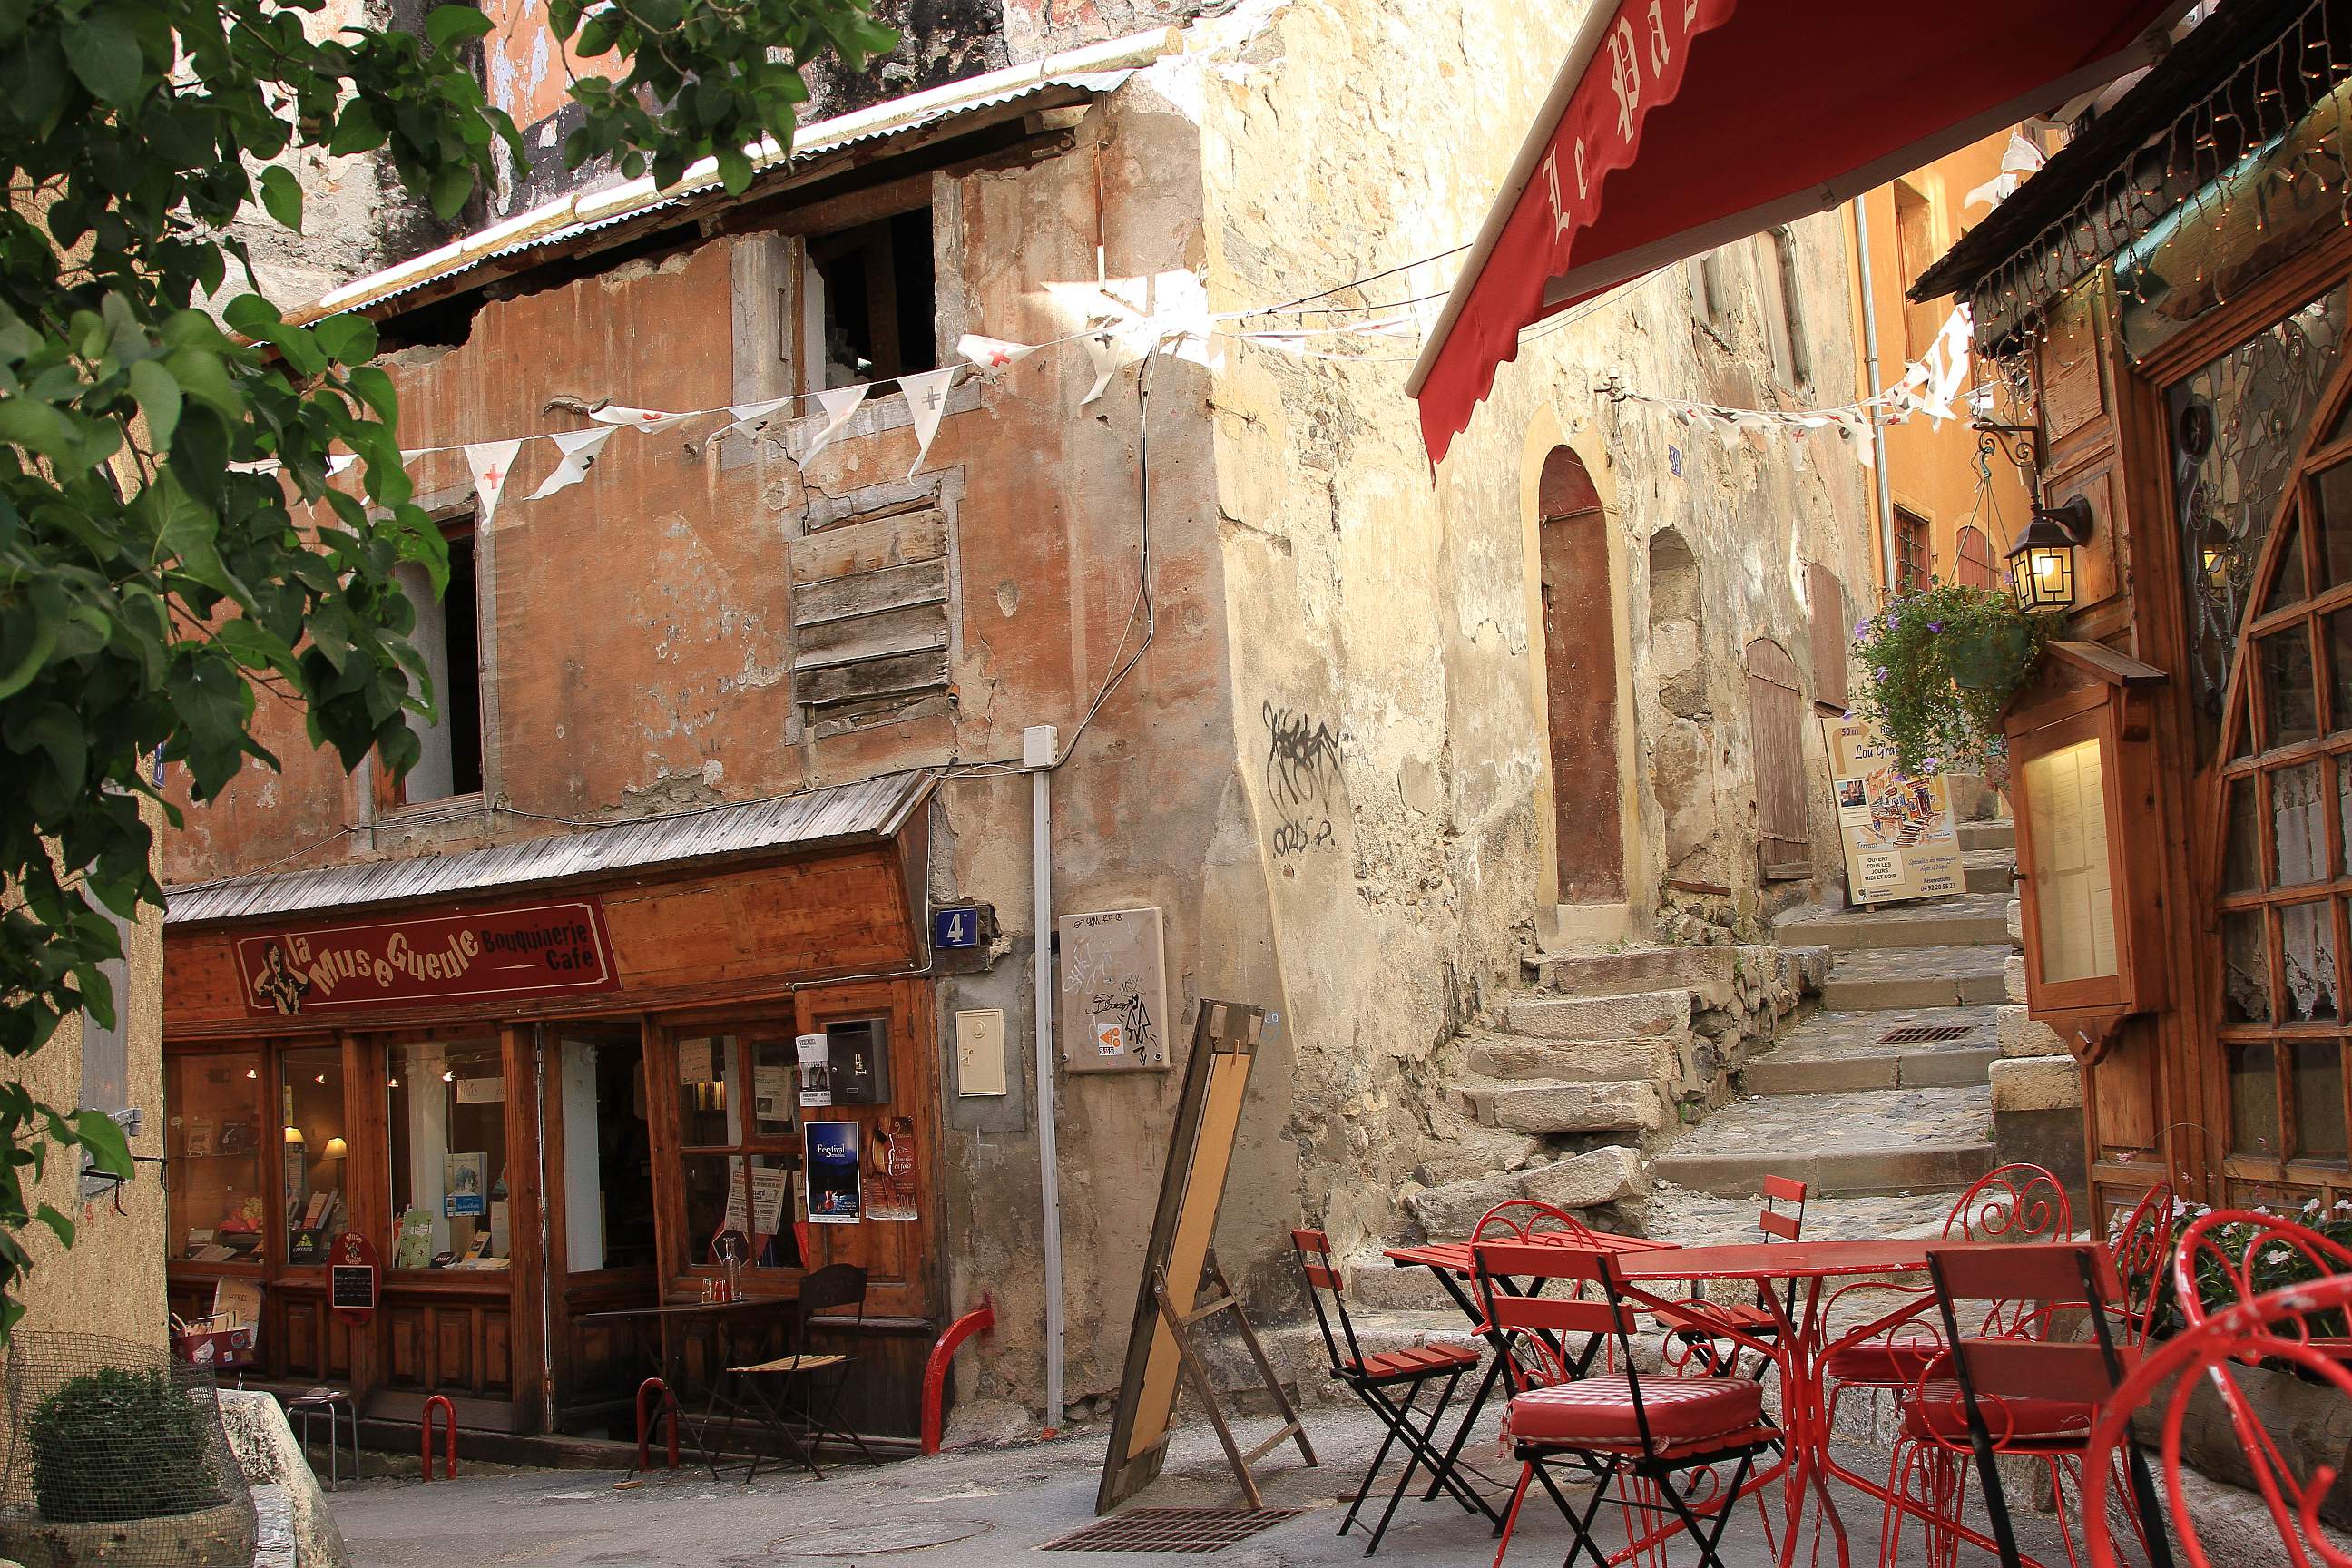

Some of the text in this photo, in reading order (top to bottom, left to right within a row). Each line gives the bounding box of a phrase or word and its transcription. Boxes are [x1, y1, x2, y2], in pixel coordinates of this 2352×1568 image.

[1543, 137, 1589, 245] Le
[1855, 744, 1873, 760] Lou
[481, 919, 589, 955] Bouquinerie
[946, 913, 964, 942] 4
[285, 933, 312, 966] la
[309, 929, 479, 996] Muse Gueule
[546, 945, 594, 973] Café
